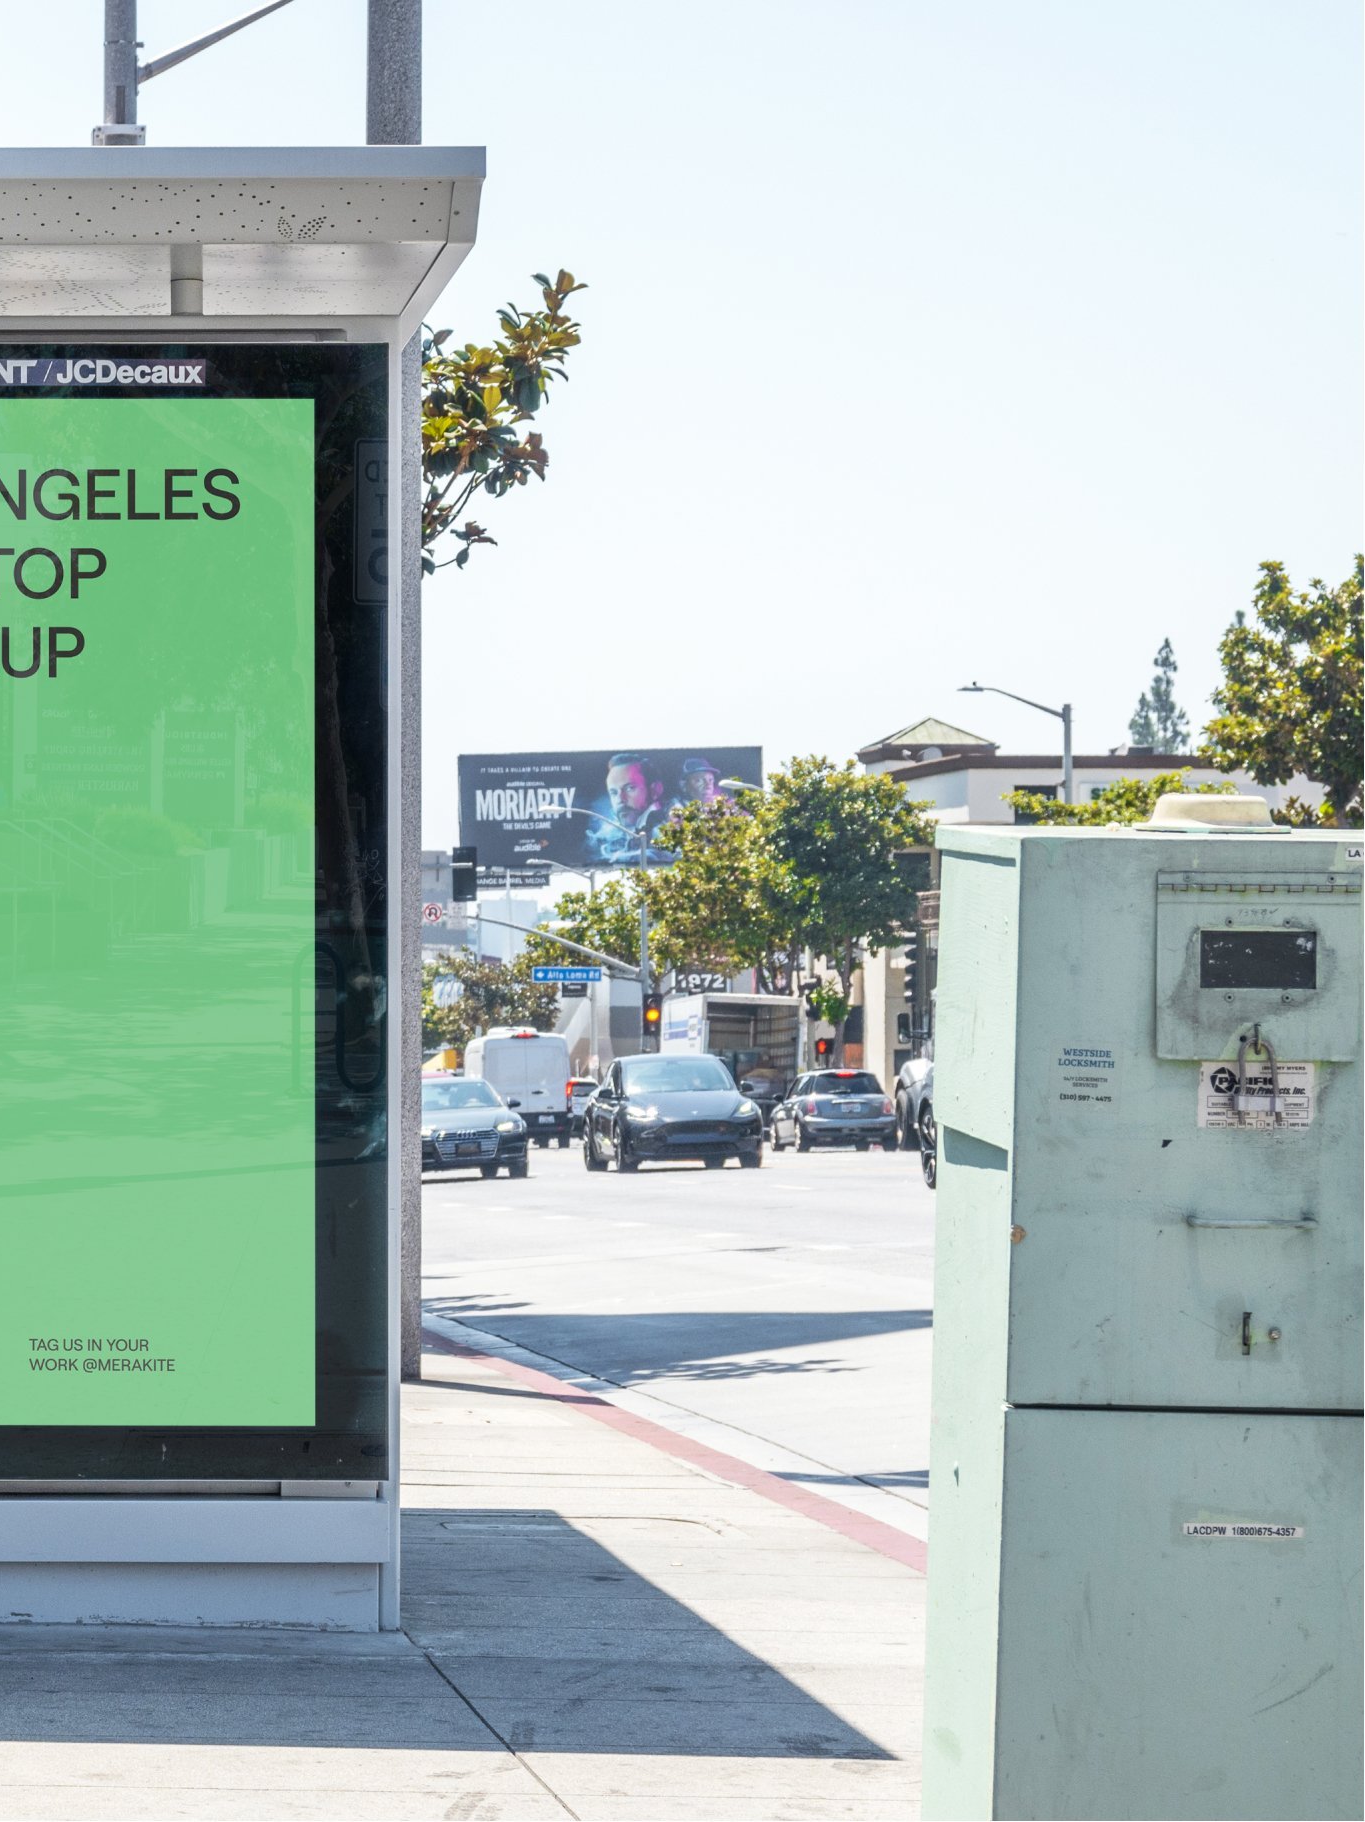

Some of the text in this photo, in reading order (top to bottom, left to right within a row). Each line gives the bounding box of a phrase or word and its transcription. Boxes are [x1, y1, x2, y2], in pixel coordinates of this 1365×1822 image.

[56, 359, 203, 385] JCDecaux
[475, 787, 576, 821] MORIARTY
[503, 822, 513, 830] THE
[535, 821, 551, 829] GAME
[1347, 850, 1361, 858] LA
[589, 971, 600, 979] Rd
[678, 973, 724, 988] 1972
[1062, 1048, 1112, 1058] WESTSIDE
[1058, 1058, 1115, 1069] LOCKSMITH
[1292, 1086, 1306, 1095] Inc.
[1060, 1093, 1077, 1102] (310)
[29, 1338, 149, 1352] TAG US IN YOUR
[29, 1358, 176, 1374] WORK @MERAKITE
[1187, 1526, 1296, 1537] LACDPW 1(800)675-4357
